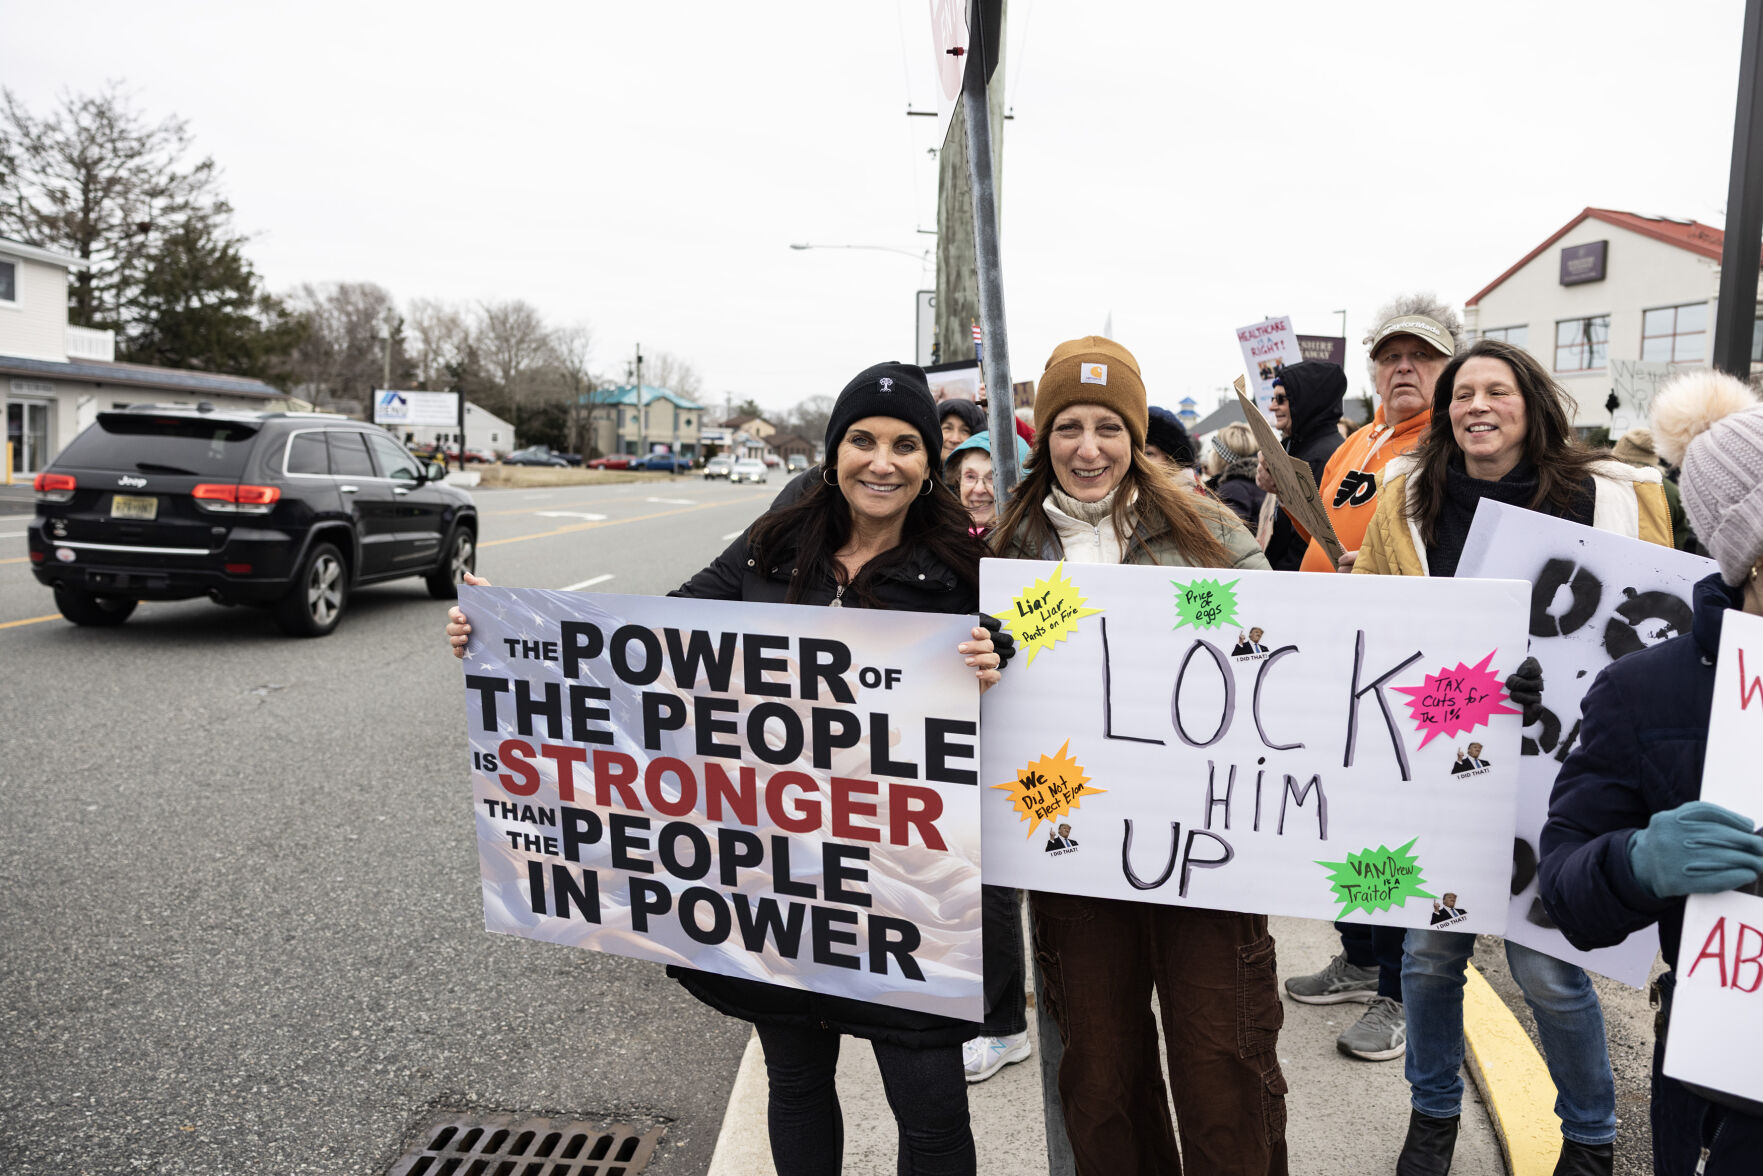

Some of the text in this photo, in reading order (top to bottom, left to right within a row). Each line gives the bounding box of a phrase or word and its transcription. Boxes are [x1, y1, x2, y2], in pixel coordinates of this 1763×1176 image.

[1237, 320, 1287, 342] HEALTHCARE
[1250, 340, 1286, 357] RIGHT!
[1300, 341, 1334, 351] SHIRE
[1301, 350, 1330, 360] AWAY
[118, 475, 147, 488] Jeep
[1016, 590, 1050, 617] Liar
[1185, 590, 1213, 604] Price
[1195, 604, 1222, 624] eggs
[1022, 625, 1046, 642] Pants
[1050, 621, 1060, 630] on
[503, 620, 903, 705] THE POWER OF
[1251, 653, 1268, 661] THAT!
[1435, 677, 1465, 693] TAX
[1100, 616, 1423, 782] LOCK
[1465, 688, 1490, 706] for
[1444, 708, 1461, 723] 1%
[465, 675, 979, 787] THE PEOPLE
[1019, 771, 1048, 791] We
[1472, 768, 1490, 776] THAT!
[473, 738, 949, 852] IS STRONGER
[1022, 775, 1067, 810] Did Not
[1035, 783, 1084, 820] Elect Elon
[483, 798, 557, 827] THAN
[505, 805, 874, 908] THE PEOPLE
[1063, 847, 1078, 855] THAT!
[1121, 818, 1235, 898] UP
[1340, 884, 1400, 904] Traitor
[527, 860, 928, 983] IN POWER
[1440, 921, 1449, 929] DID
[1450, 915, 1467, 925] THAT!
